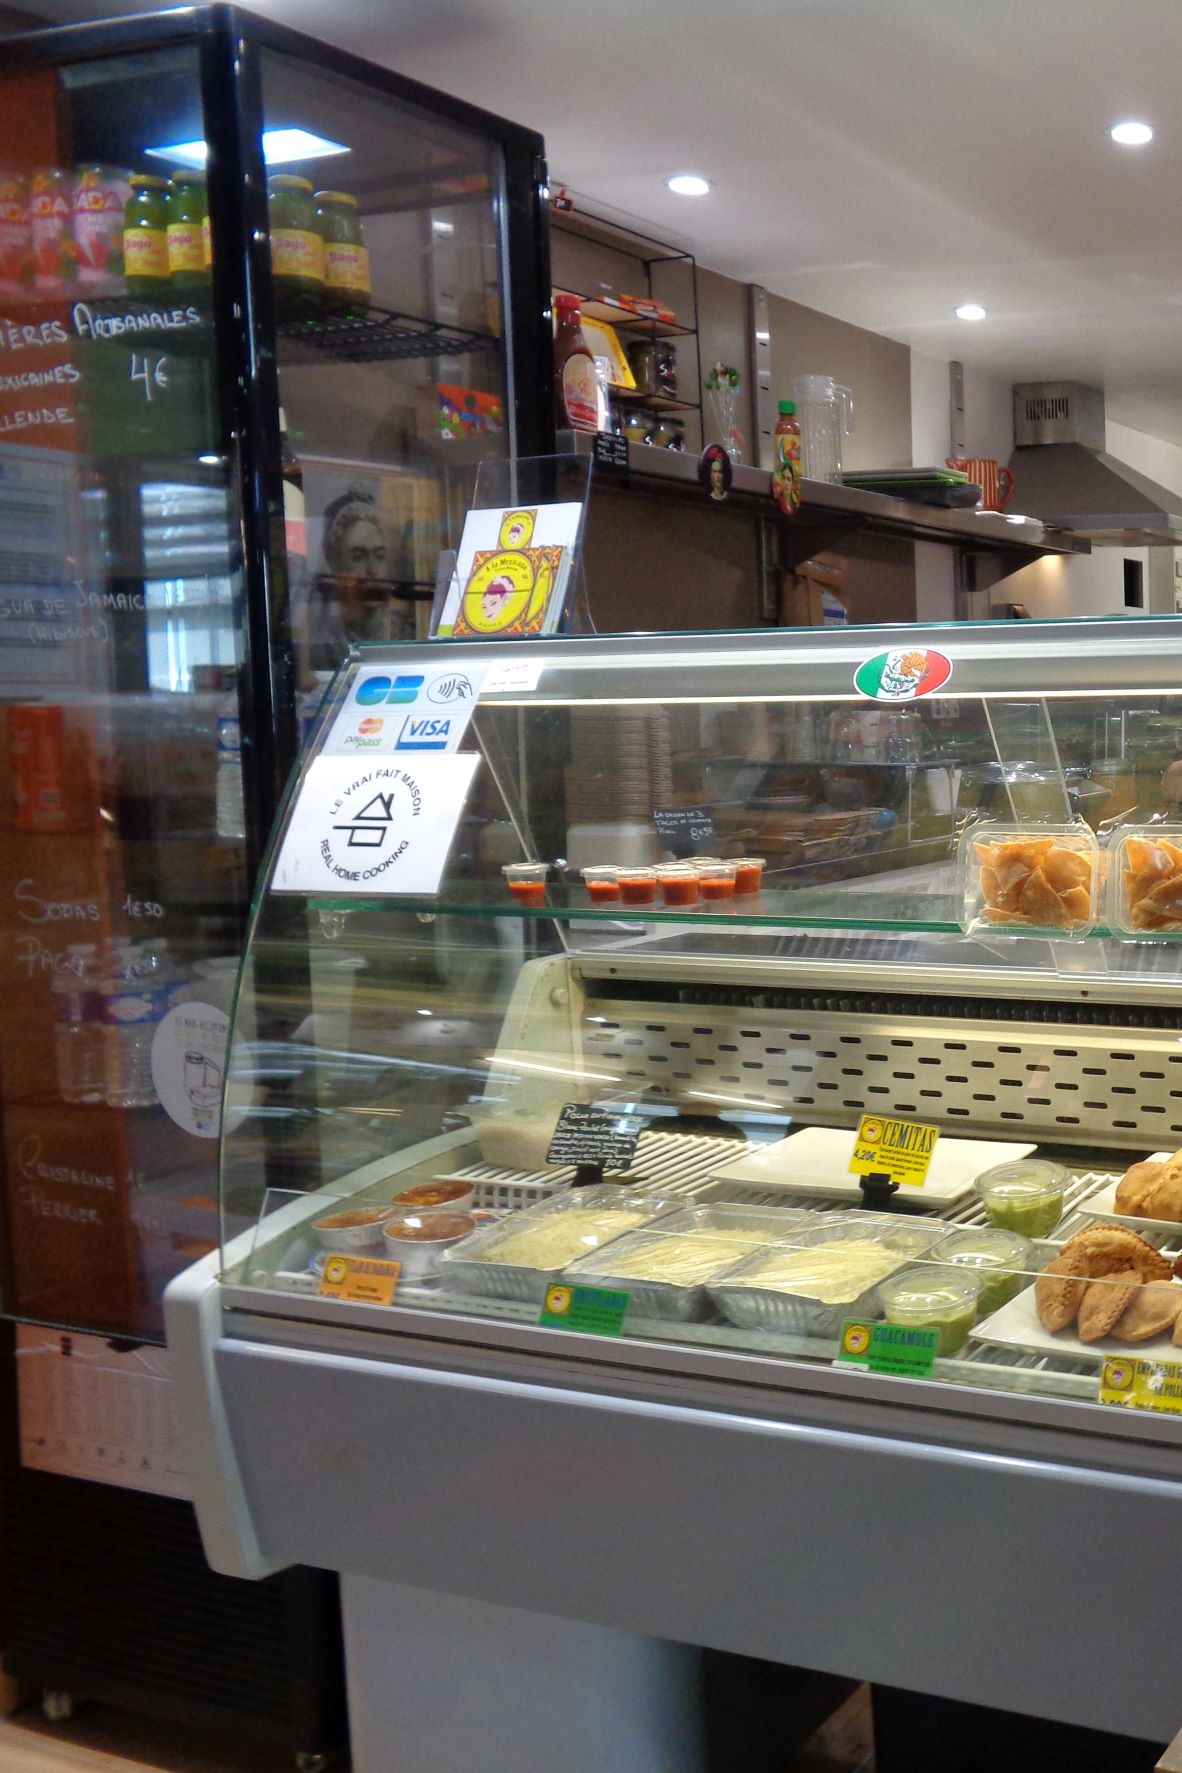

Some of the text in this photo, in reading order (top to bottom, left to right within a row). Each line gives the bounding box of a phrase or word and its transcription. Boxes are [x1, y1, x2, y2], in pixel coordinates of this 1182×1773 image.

[130, 353, 169, 402] 4€
[408, 719, 451, 737] VISA
[329, 768, 422, 816] LE VRAI FAIT MAISON
[320, 838, 410, 882] REAL HOME COOKING
[882, 1121, 936, 1153] CEMITAS
[873, 1327, 935, 1348] GUACAMOLE
